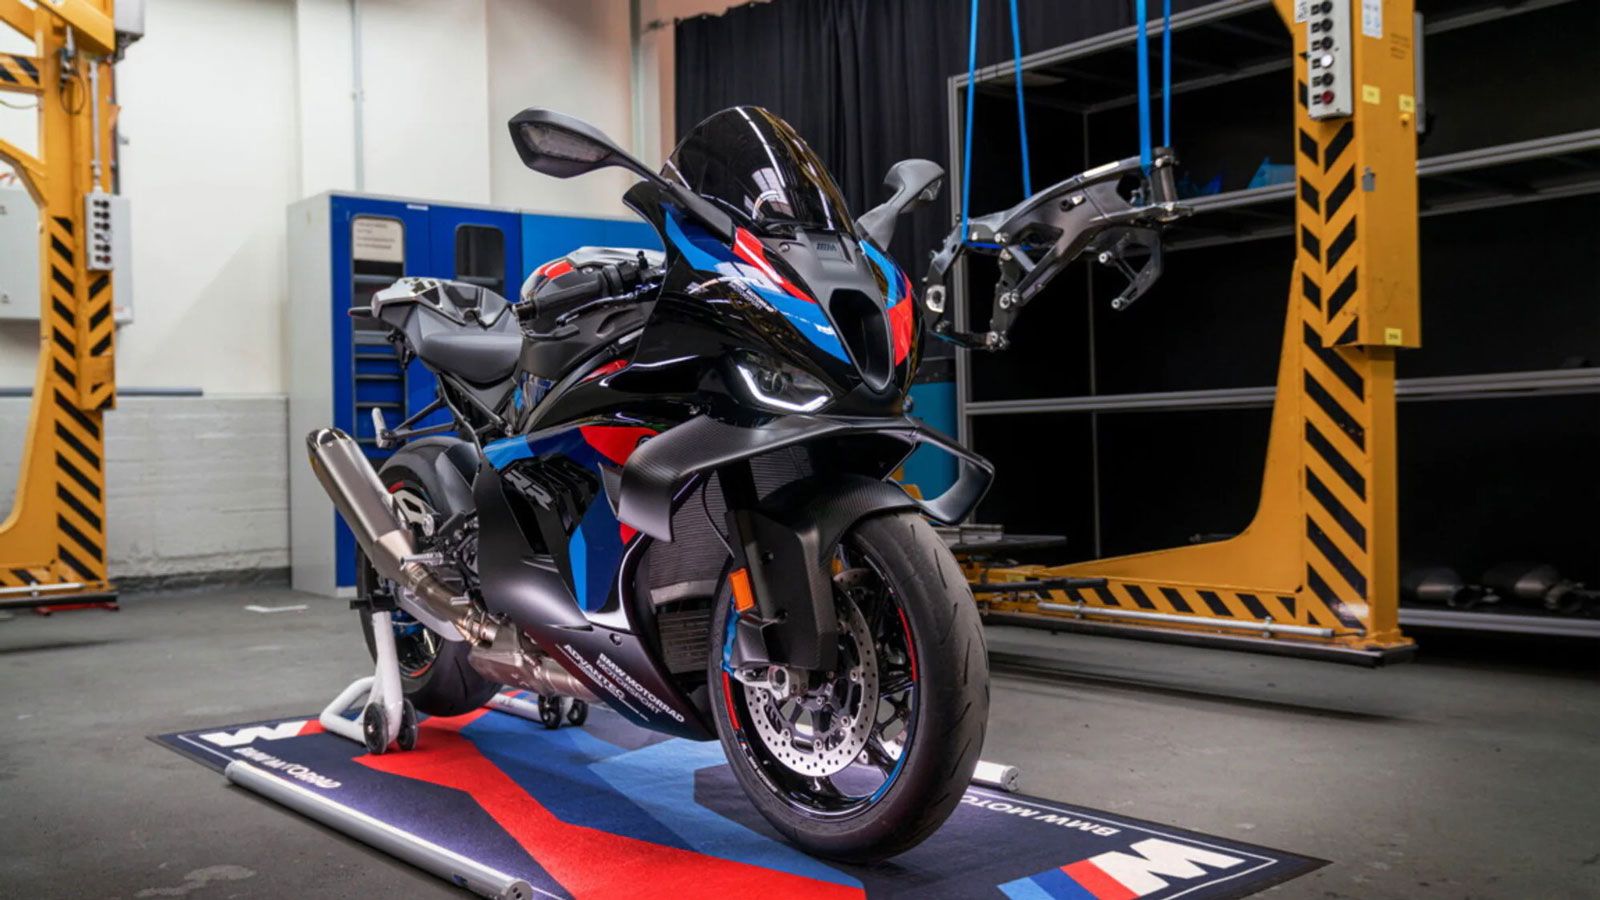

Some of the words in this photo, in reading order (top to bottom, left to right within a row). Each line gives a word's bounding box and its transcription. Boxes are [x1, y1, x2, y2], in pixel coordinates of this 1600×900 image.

[504, 469, 552, 511] RR
[596, 659, 661, 714] MOTORSPORT
[599, 653, 625, 677] BMW
[625, 675, 685, 722] MOTORRAD
[960, 795, 1040, 817] MOTO
[1033, 814, 1121, 837] BMW
